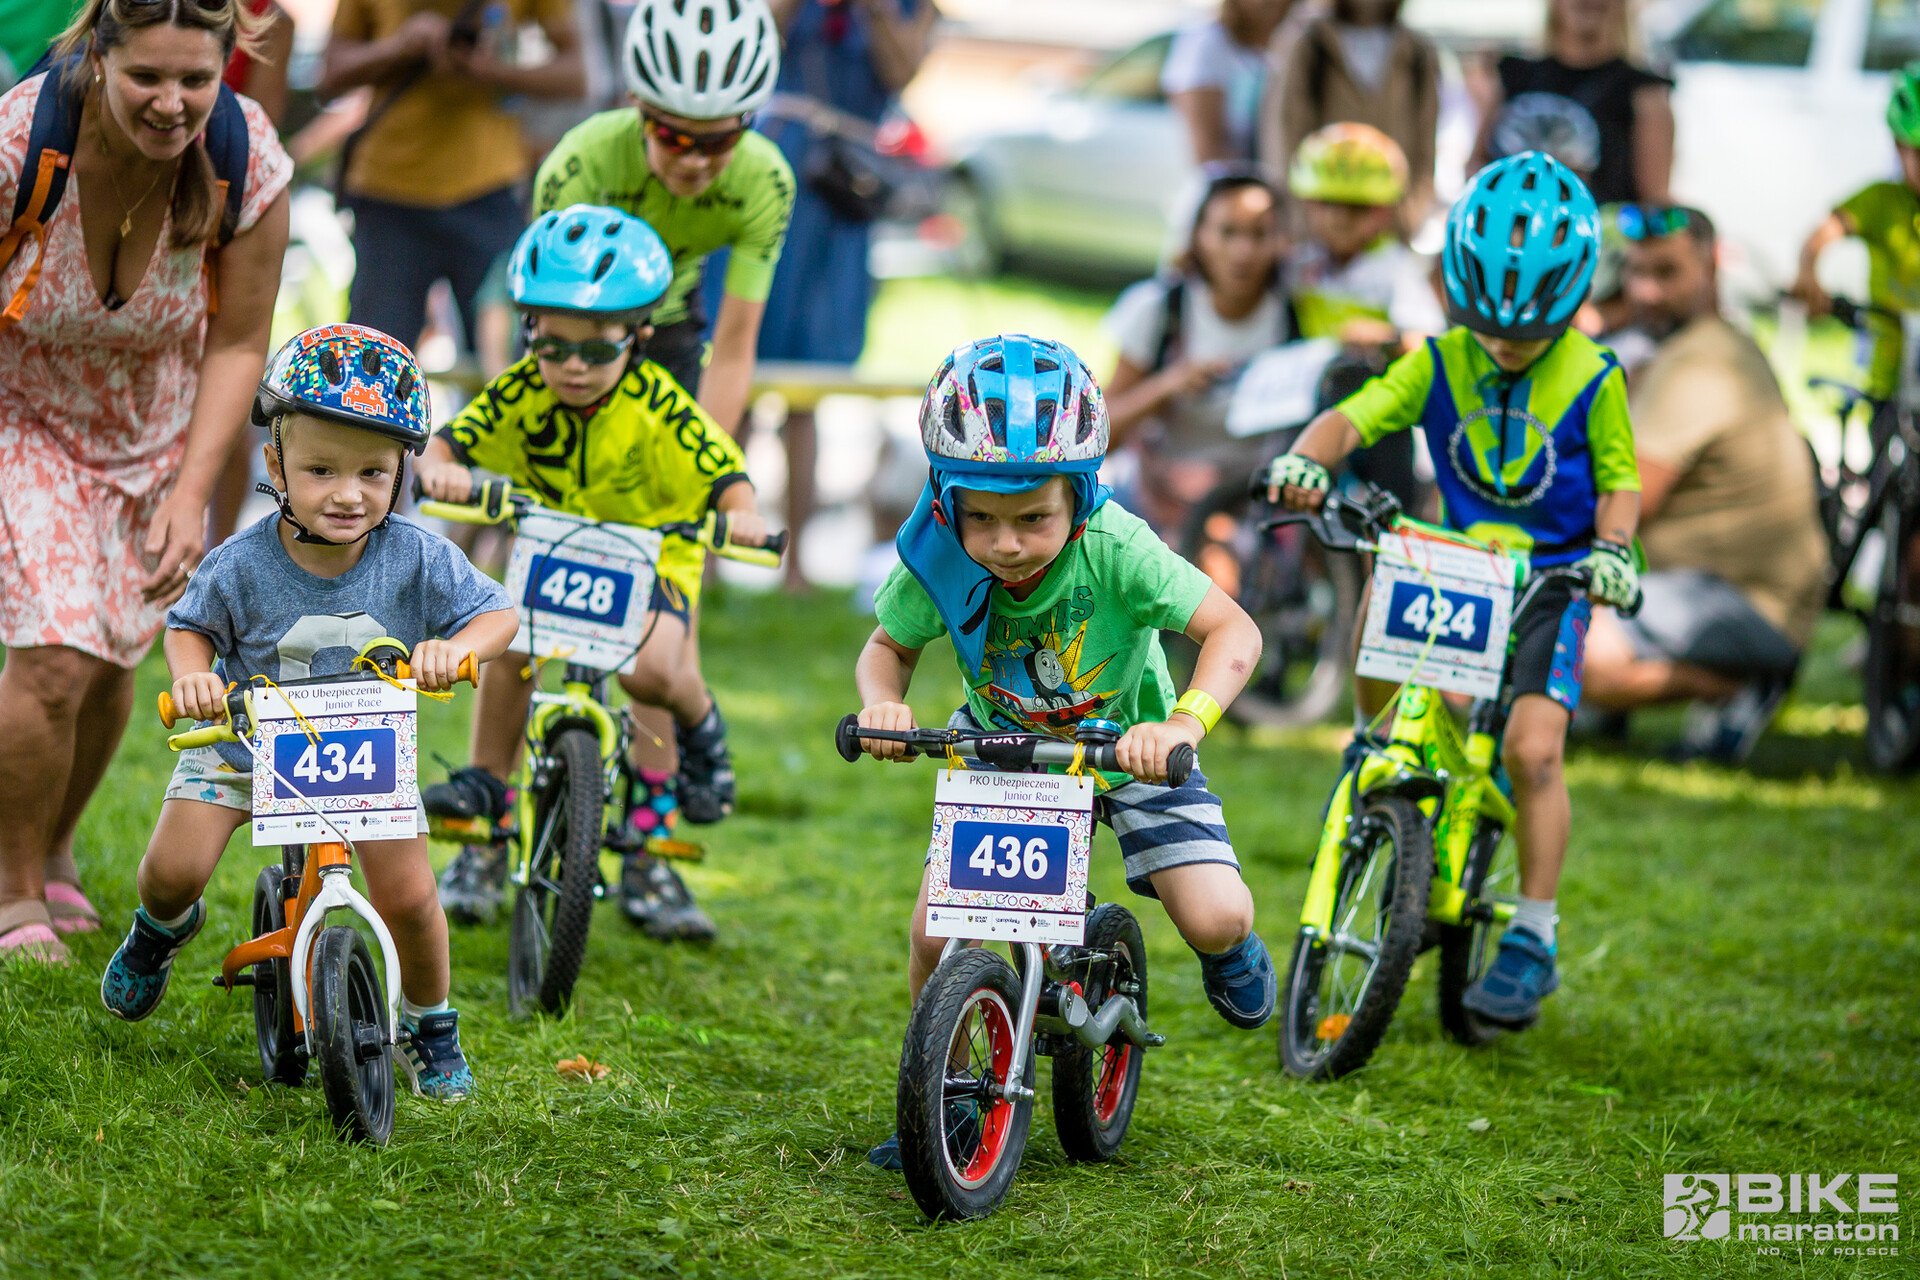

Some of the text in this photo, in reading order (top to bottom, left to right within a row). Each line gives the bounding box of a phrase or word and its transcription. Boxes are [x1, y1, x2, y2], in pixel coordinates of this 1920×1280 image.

[623, 364, 735, 476] Swee
[540, 567, 616, 615] 428
[1402, 593, 1476, 641] 424
[288, 685, 382, 700] PKO Ubezpieczenia
[324, 699, 382, 712] Junior Race
[293, 741, 376, 784] 434
[969, 775, 1060, 790] PKO Ubezpieczenia
[1003, 790, 1059, 803] Junior Race
[969, 834, 1049, 880] 436
